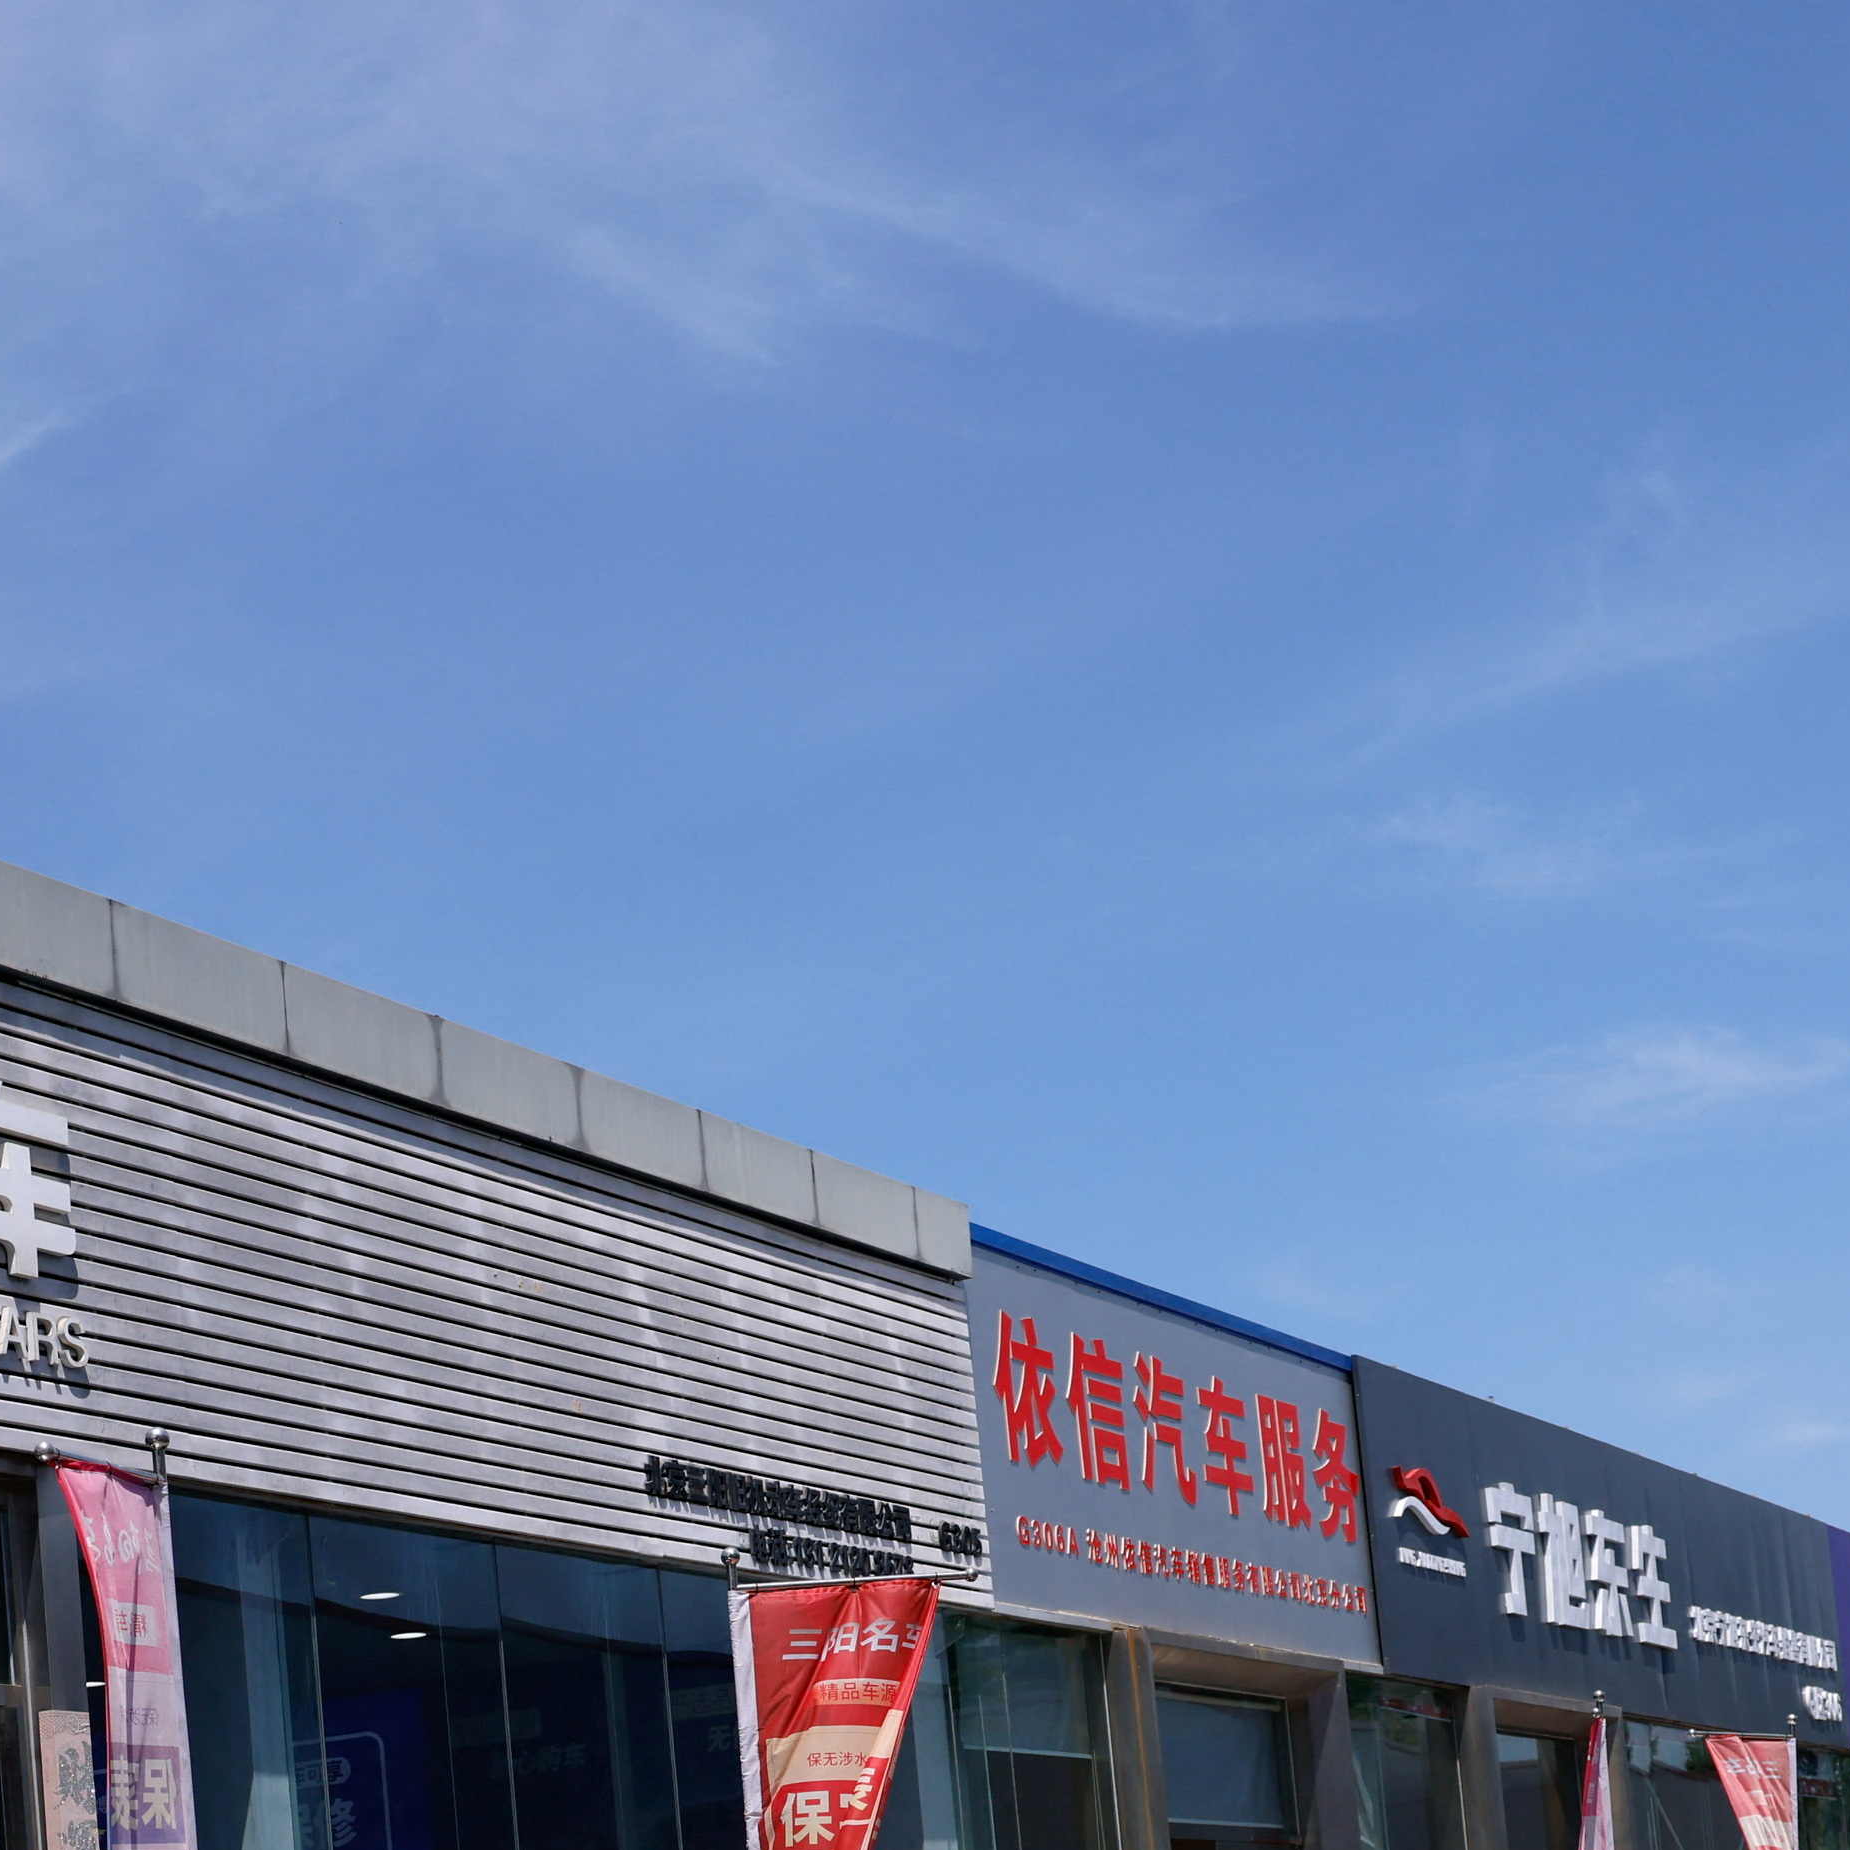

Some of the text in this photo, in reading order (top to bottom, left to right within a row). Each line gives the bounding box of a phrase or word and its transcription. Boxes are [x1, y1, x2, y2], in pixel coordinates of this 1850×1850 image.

[993, 1309, 1360, 1543] 依信汽车服务
[1016, 1515, 1080, 1556] G306A
[817, 1679, 899, 1704] 精品车源
